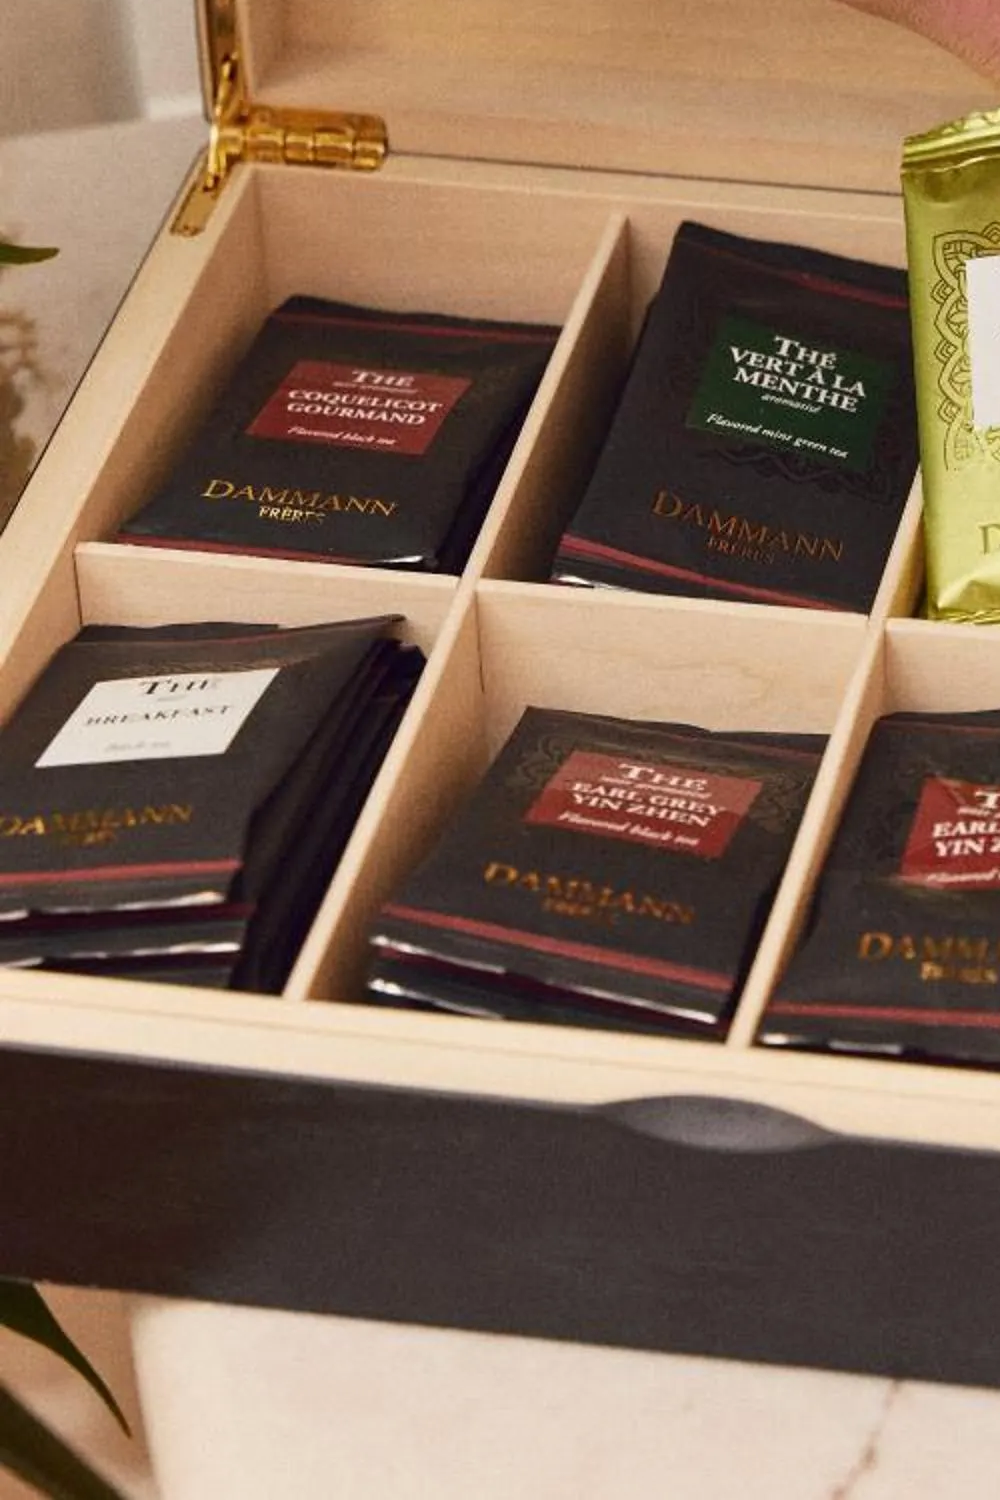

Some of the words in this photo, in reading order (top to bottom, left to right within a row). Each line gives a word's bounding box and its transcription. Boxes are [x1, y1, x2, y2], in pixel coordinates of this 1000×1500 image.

[730, 345, 804, 377] VERT
[832, 374, 866, 398] LA
[287, 389, 443, 412] COQUELICOT
[732, 366, 860, 413] MENTHE
[287, 403, 426, 425] GOURMAND
[200, 479, 398, 517] DAMMANN
[651, 490, 844, 562] DAMMANN
[571, 782, 643, 802] EARL
[649, 795, 726, 816] GREY
[572, 793, 622, 811] YIN
[626, 803, 712, 827] ZHEN
[935, 837, 986, 857] YIN
